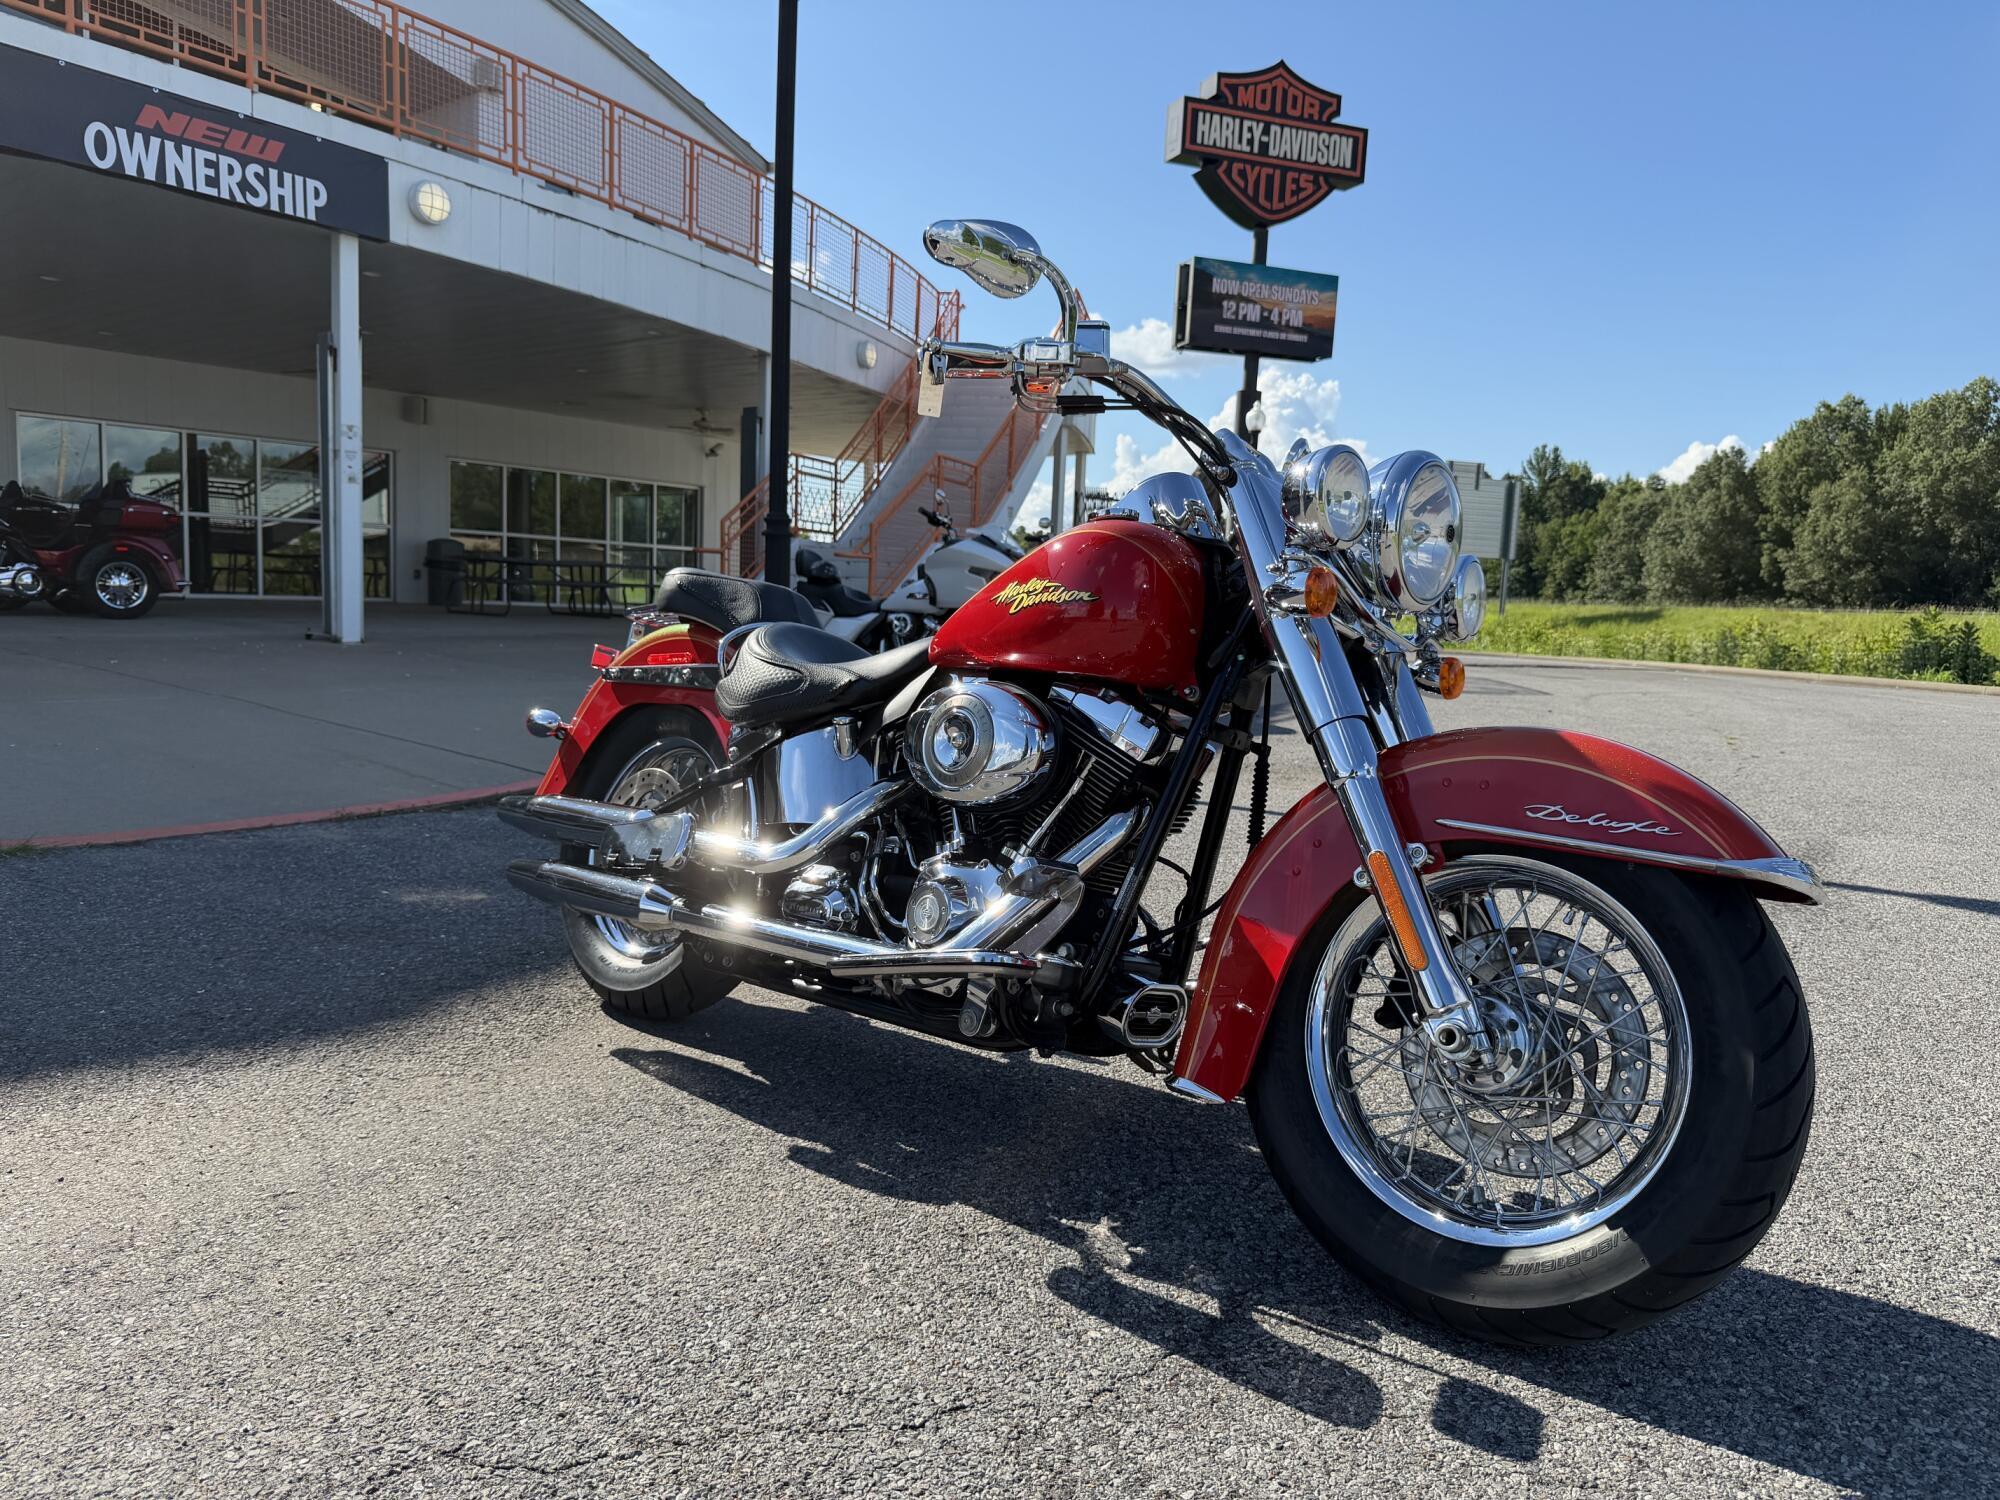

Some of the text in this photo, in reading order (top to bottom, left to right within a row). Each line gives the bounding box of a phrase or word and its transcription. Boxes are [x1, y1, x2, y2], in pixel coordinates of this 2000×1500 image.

[1237, 77, 1320, 121] MOTOR
[135, 103, 285, 163] NEW
[1196, 110, 1354, 169] HARLEY-DAVIDSON
[84, 121, 328, 221] OWNERSHIP
[1231, 162, 1315, 211] CYCLES
[1212, 278, 1319, 305] NOW OPEN SUNDAYS
[1222, 300, 1236, 319] 12
[1238, 303, 1260, 322] PM
[1270, 307, 1279, 325] 4
[1281, 308, 1303, 328] PM
[1009, 587, 1100, 614] Davidson
[1524, 804, 1682, 836] Deluxe
